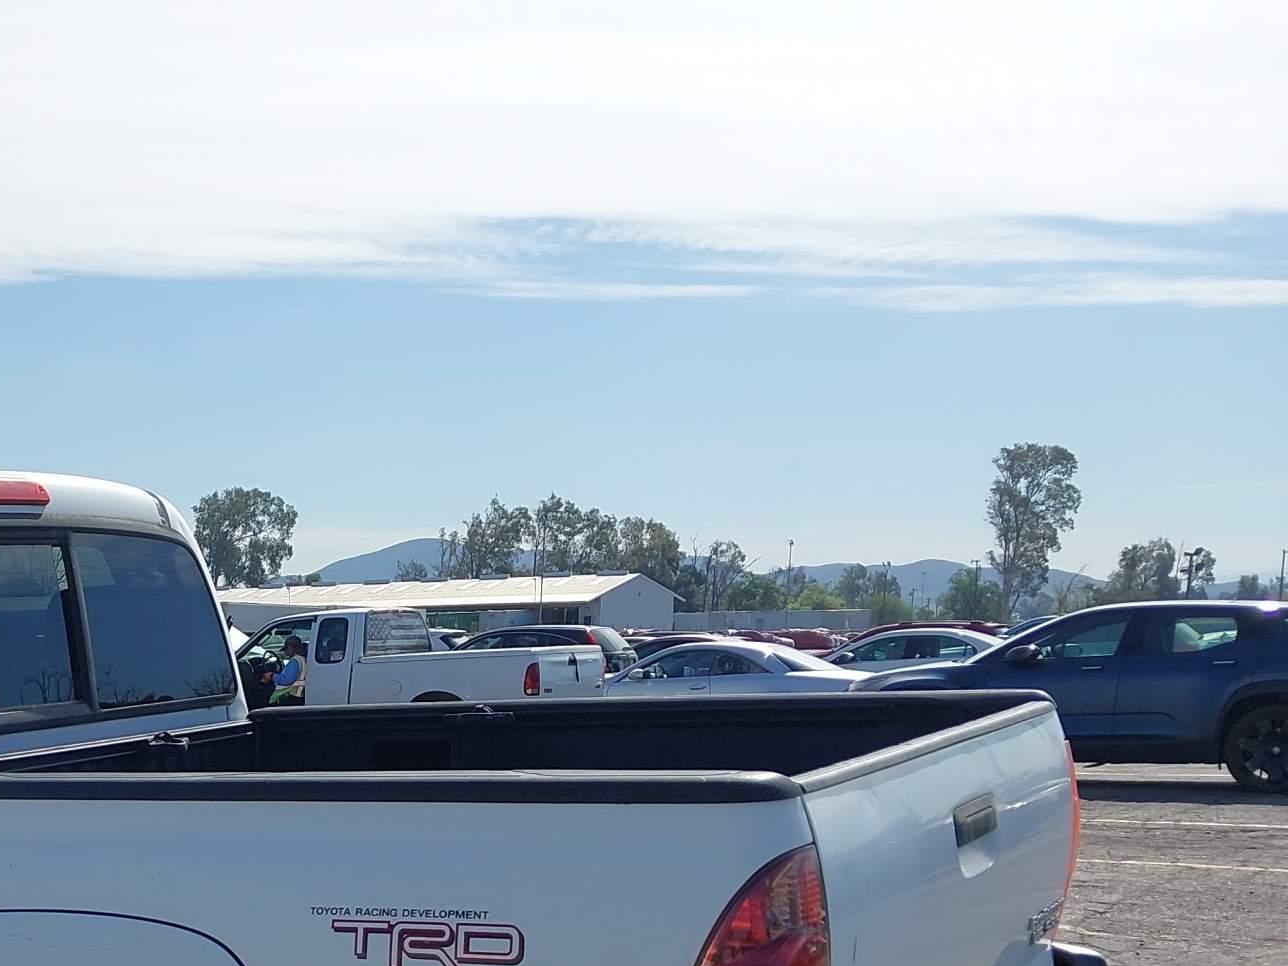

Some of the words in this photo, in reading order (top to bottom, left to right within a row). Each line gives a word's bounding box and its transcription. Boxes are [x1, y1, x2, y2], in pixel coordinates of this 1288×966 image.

[310, 906, 350, 916] TOYOTA
[355, 907, 398, 918] RACING
[402, 908, 489, 920] DEVELOPMENT
